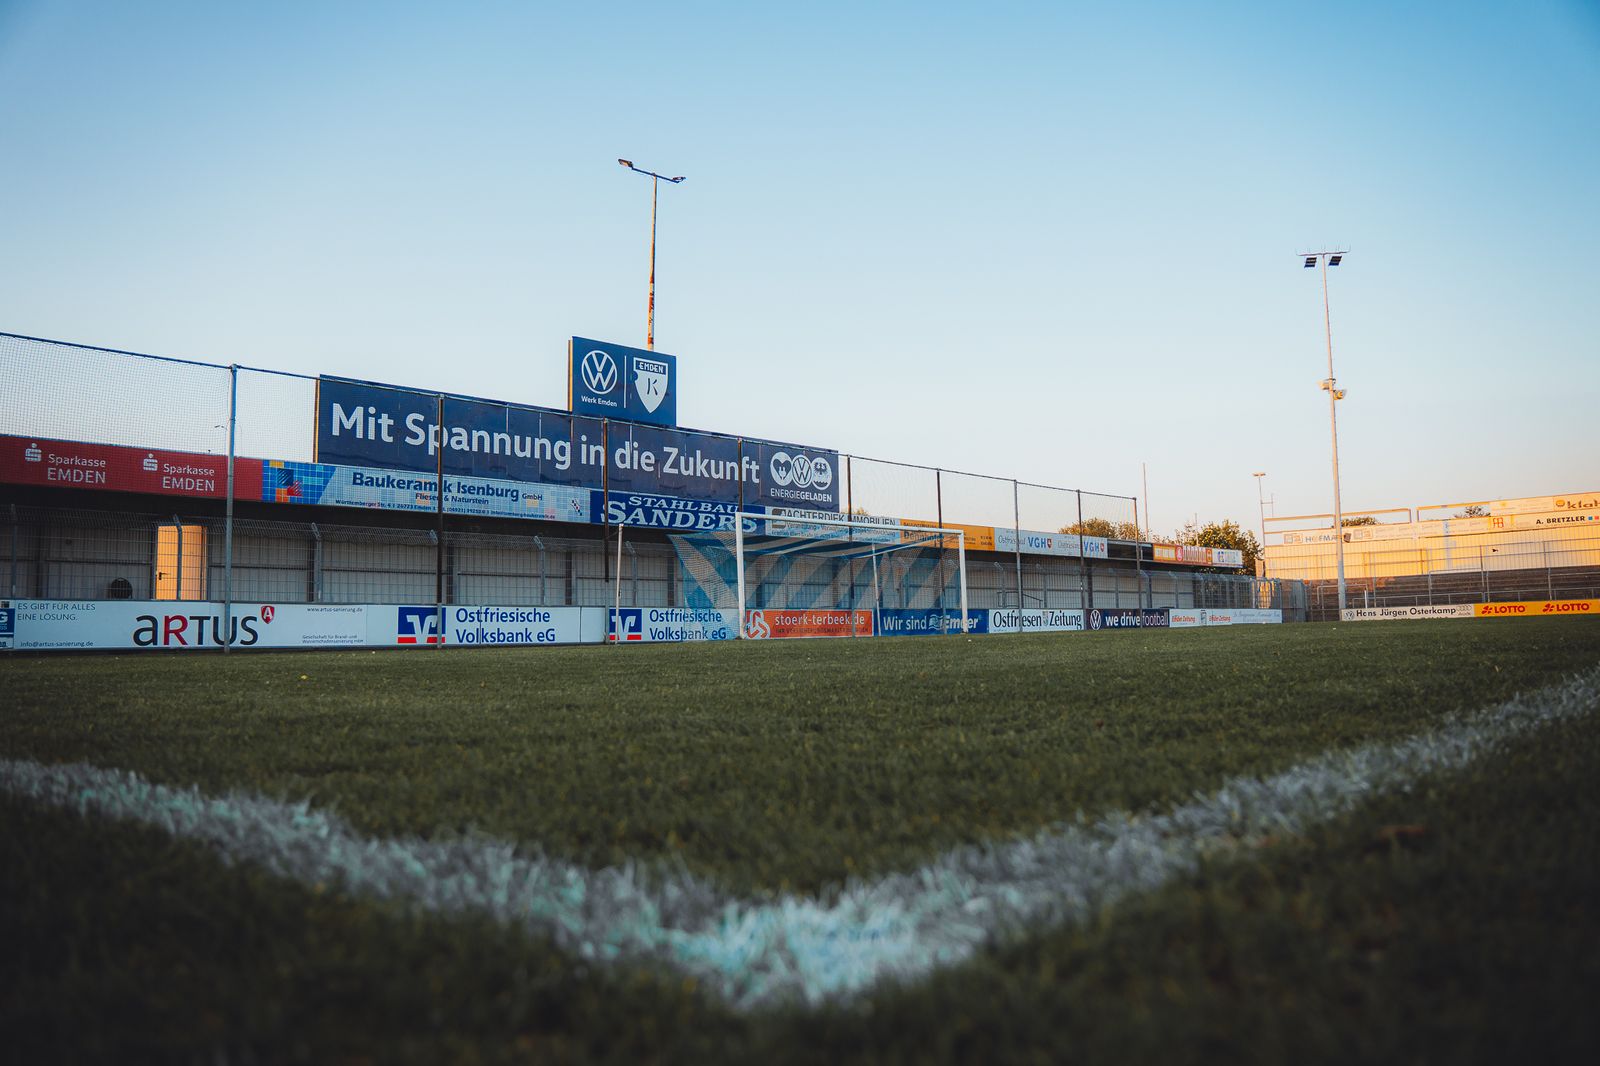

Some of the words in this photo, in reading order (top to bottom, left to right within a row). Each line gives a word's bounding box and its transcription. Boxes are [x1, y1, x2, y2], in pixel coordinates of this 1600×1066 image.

[639, 362, 664, 374] EMDEN
[647, 377, 658, 396] K
[581, 395, 597, 404] Werk
[598, 398, 618, 407] Emden
[332, 402, 393, 443] Mit
[405, 413, 571, 470] Spannung
[581, 434, 604, 468] in
[615, 441, 655, 473] die
[663, 447, 760, 484] Zukunft
[48, 453, 106, 469] Sparkasse
[47, 467, 106, 484] EMDEN
[163, 463, 215, 477] Sparkasse
[162, 476, 215, 491] EMDEN
[352, 472, 452, 493] Baukeramk
[457, 482, 519, 502] Isenburg
[522, 493, 543, 501] GmbH
[451, 495, 489, 505] Naturstein
[770, 487, 832, 502] ENERGIEGELADEN
[628, 496, 738, 514] STAHLBAU
[600, 501, 757, 533] SANDERS
[1547, 515, 1585, 524] BRETZLER
[1027, 536, 1046, 549] VGH
[1083, 541, 1099, 552] VGH
[71, 603, 96, 611] ALLES
[1379, 608, 1408, 617] Jürgen
[1409, 607, 1457, 616] Osterkamp
[1494, 605, 1526, 614] LOTTO
[1556, 603, 1589, 611] LOTTO
[17, 613, 37, 621] EINE
[455, 607, 551, 625] Ostfriesische
[649, 608, 722, 623] Ostfriesische
[775, 613, 865, 626] stoerk-terbeek.de
[993, 610, 1042, 628] Ostfresen
[1049, 610, 1082, 630] Zeitung
[1105, 616, 1119, 626] we
[1120, 612, 1141, 626] drive
[1142, 612, 1168, 626] football
[883, 616, 904, 631] Wir
[905, 616, 928, 630] sind
[455, 627, 532, 644] Volksbank
[537, 628, 556, 642] eG
[649, 627, 709, 641] Volksbank
[711, 627, 727, 640] eG
